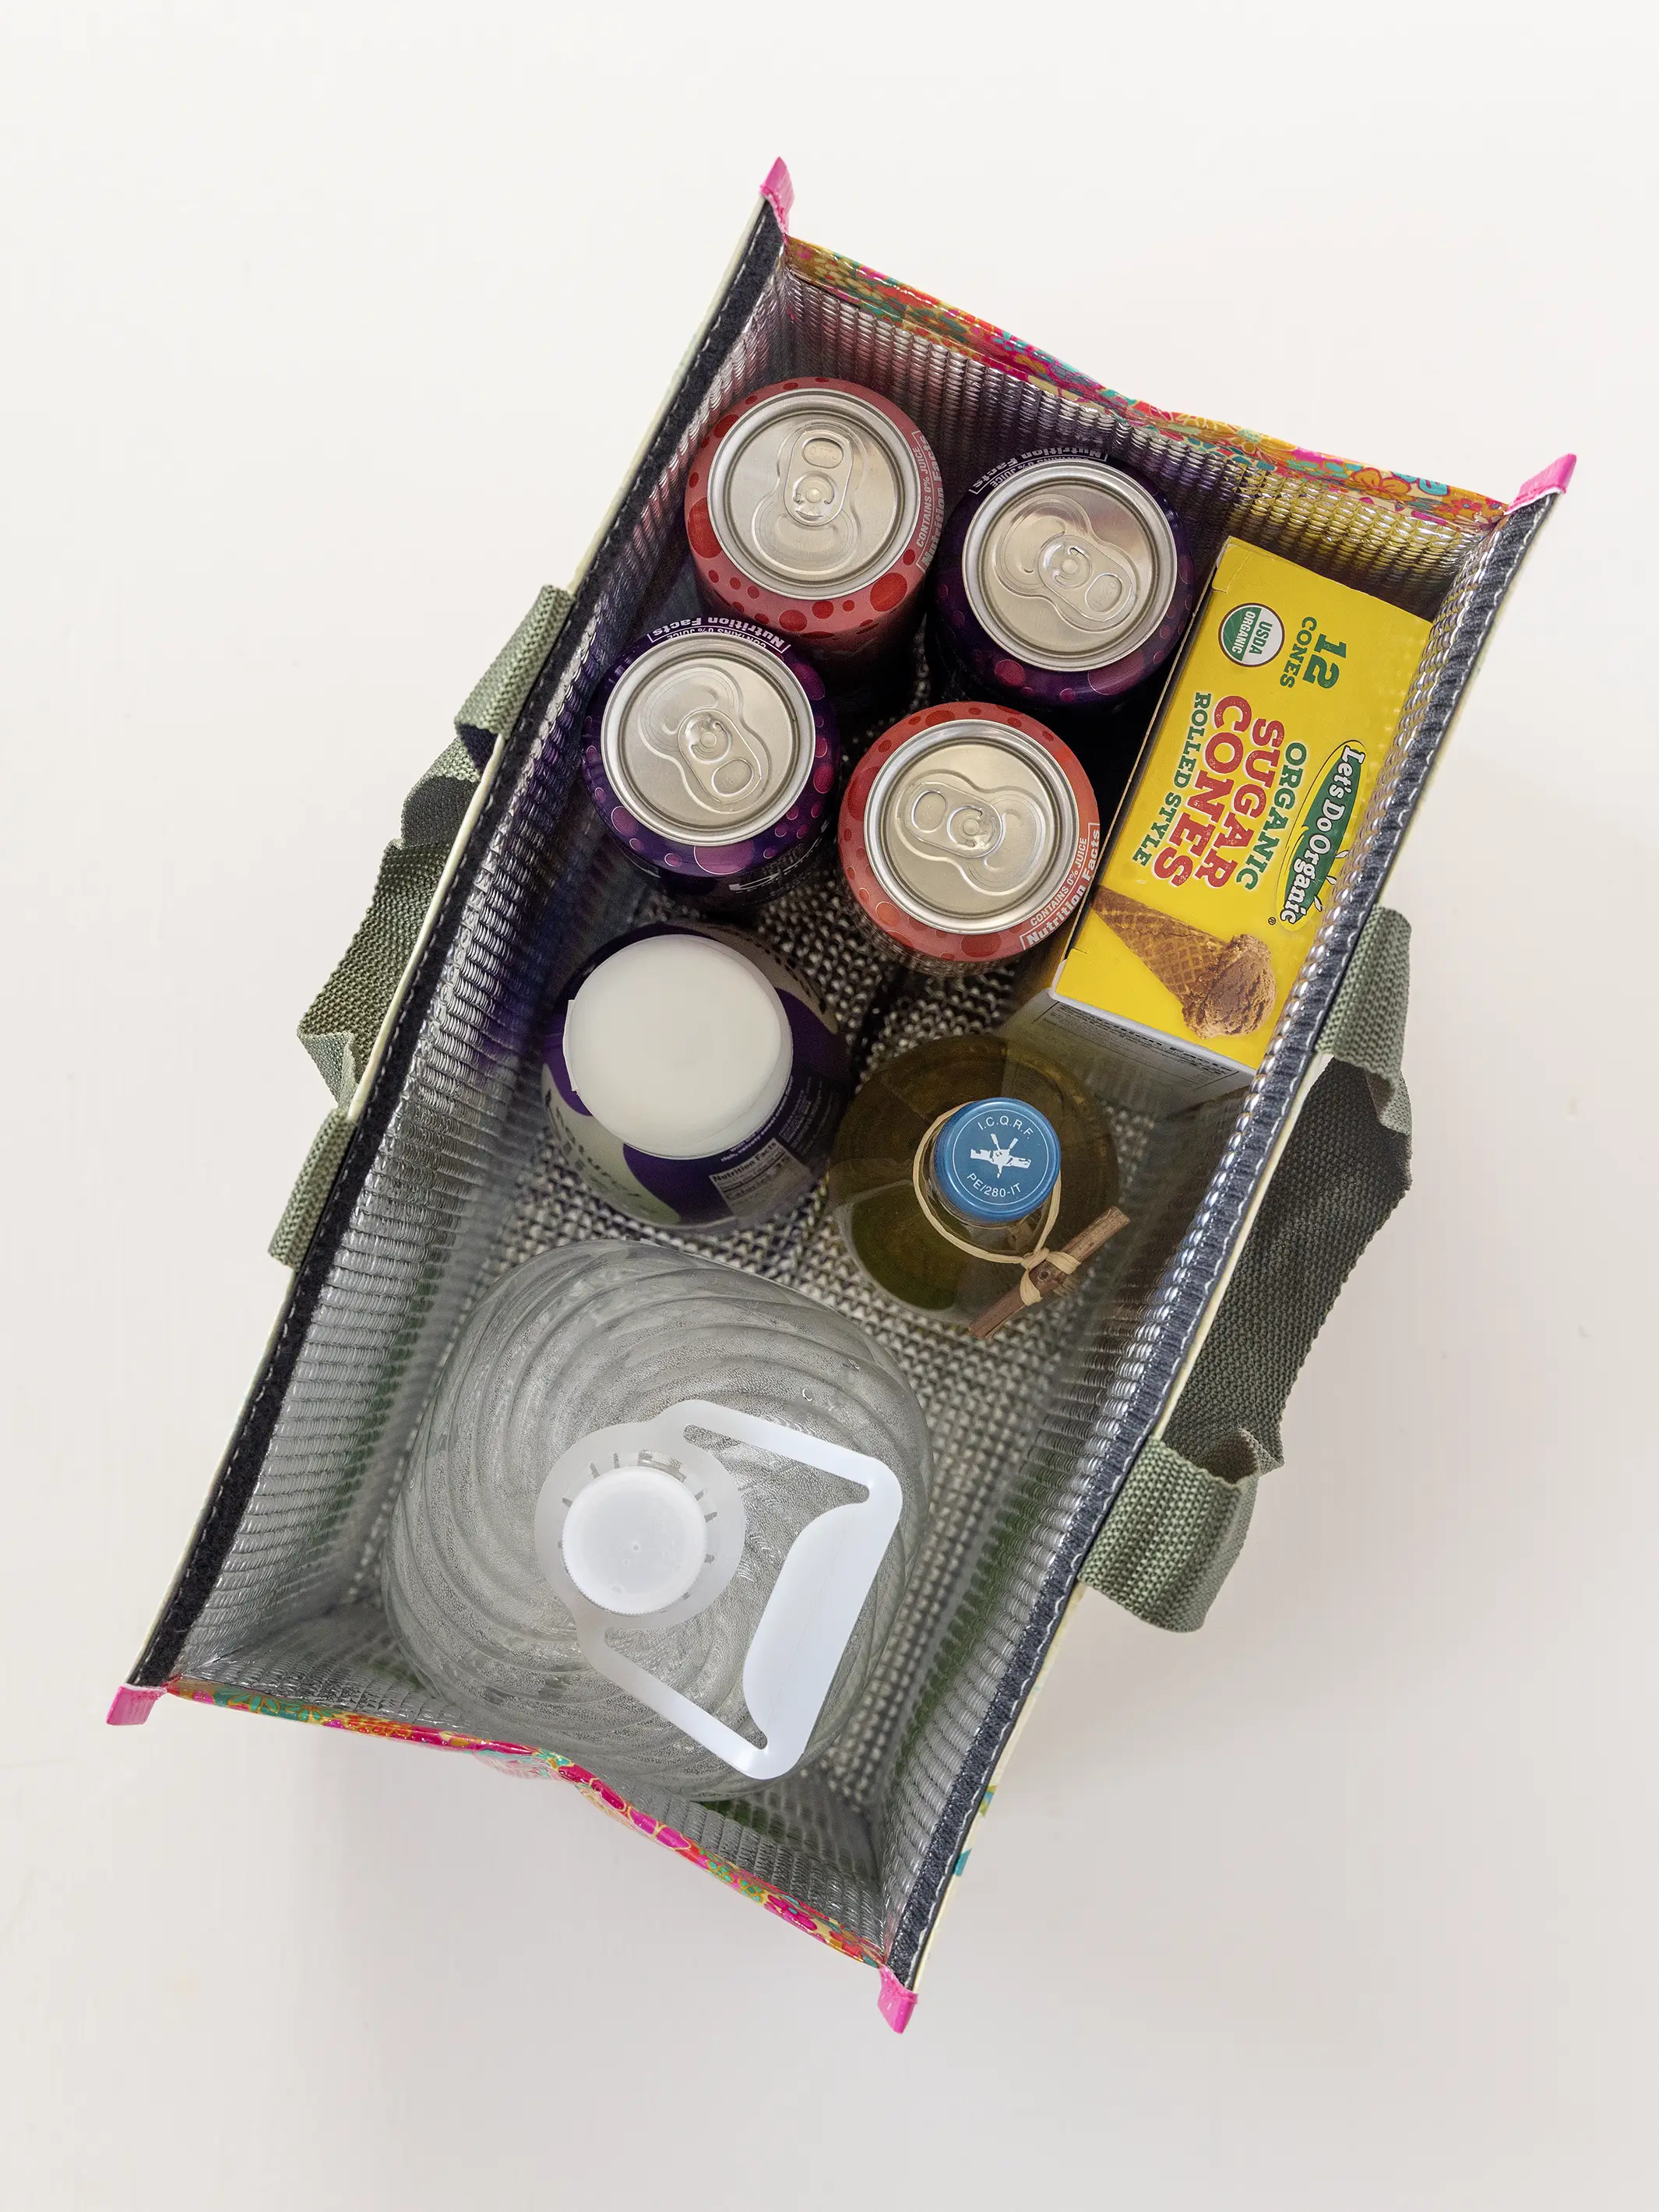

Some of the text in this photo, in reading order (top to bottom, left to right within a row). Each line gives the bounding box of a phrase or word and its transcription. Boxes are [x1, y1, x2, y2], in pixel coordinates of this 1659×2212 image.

[973, 457, 1019, 488] Facts
[989, 467, 1016, 488] JUICE
[1021, 447, 1102, 460] Nutrition
[912, 446, 932, 548] CONTAINS 0% JUICE
[920, 435, 945, 567] Nutrition Facts
[652, 617, 785, 647] Nutrition Facts
[1231, 611, 1256, 655] ORGANIC
[1249, 621, 1273, 655] USDA
[1280, 616, 1317, 689] CONES
[1302, 633, 1347, 689] 12
[1132, 692, 1212, 867] ROLLED STYLE
[1154, 696, 1252, 886] CONES
[1328, 745, 1366, 799] Let's
[1194, 718, 1285, 888] SUGAR
[1236, 742, 1307, 890] ORGANIC
[1027, 829, 1100, 946] Nutrition Facts
[1030, 837, 1087, 927] CONTAINS 0% JUICE
[1279, 833, 1332, 925] Organic
[977, 1115, 1034, 1139] I.C.Q.R.F.
[712, 1160, 756, 1182] Nutrition
[756, 1142, 777, 1161] Facts
[967, 1172, 1022, 1198] PE/280-IT
